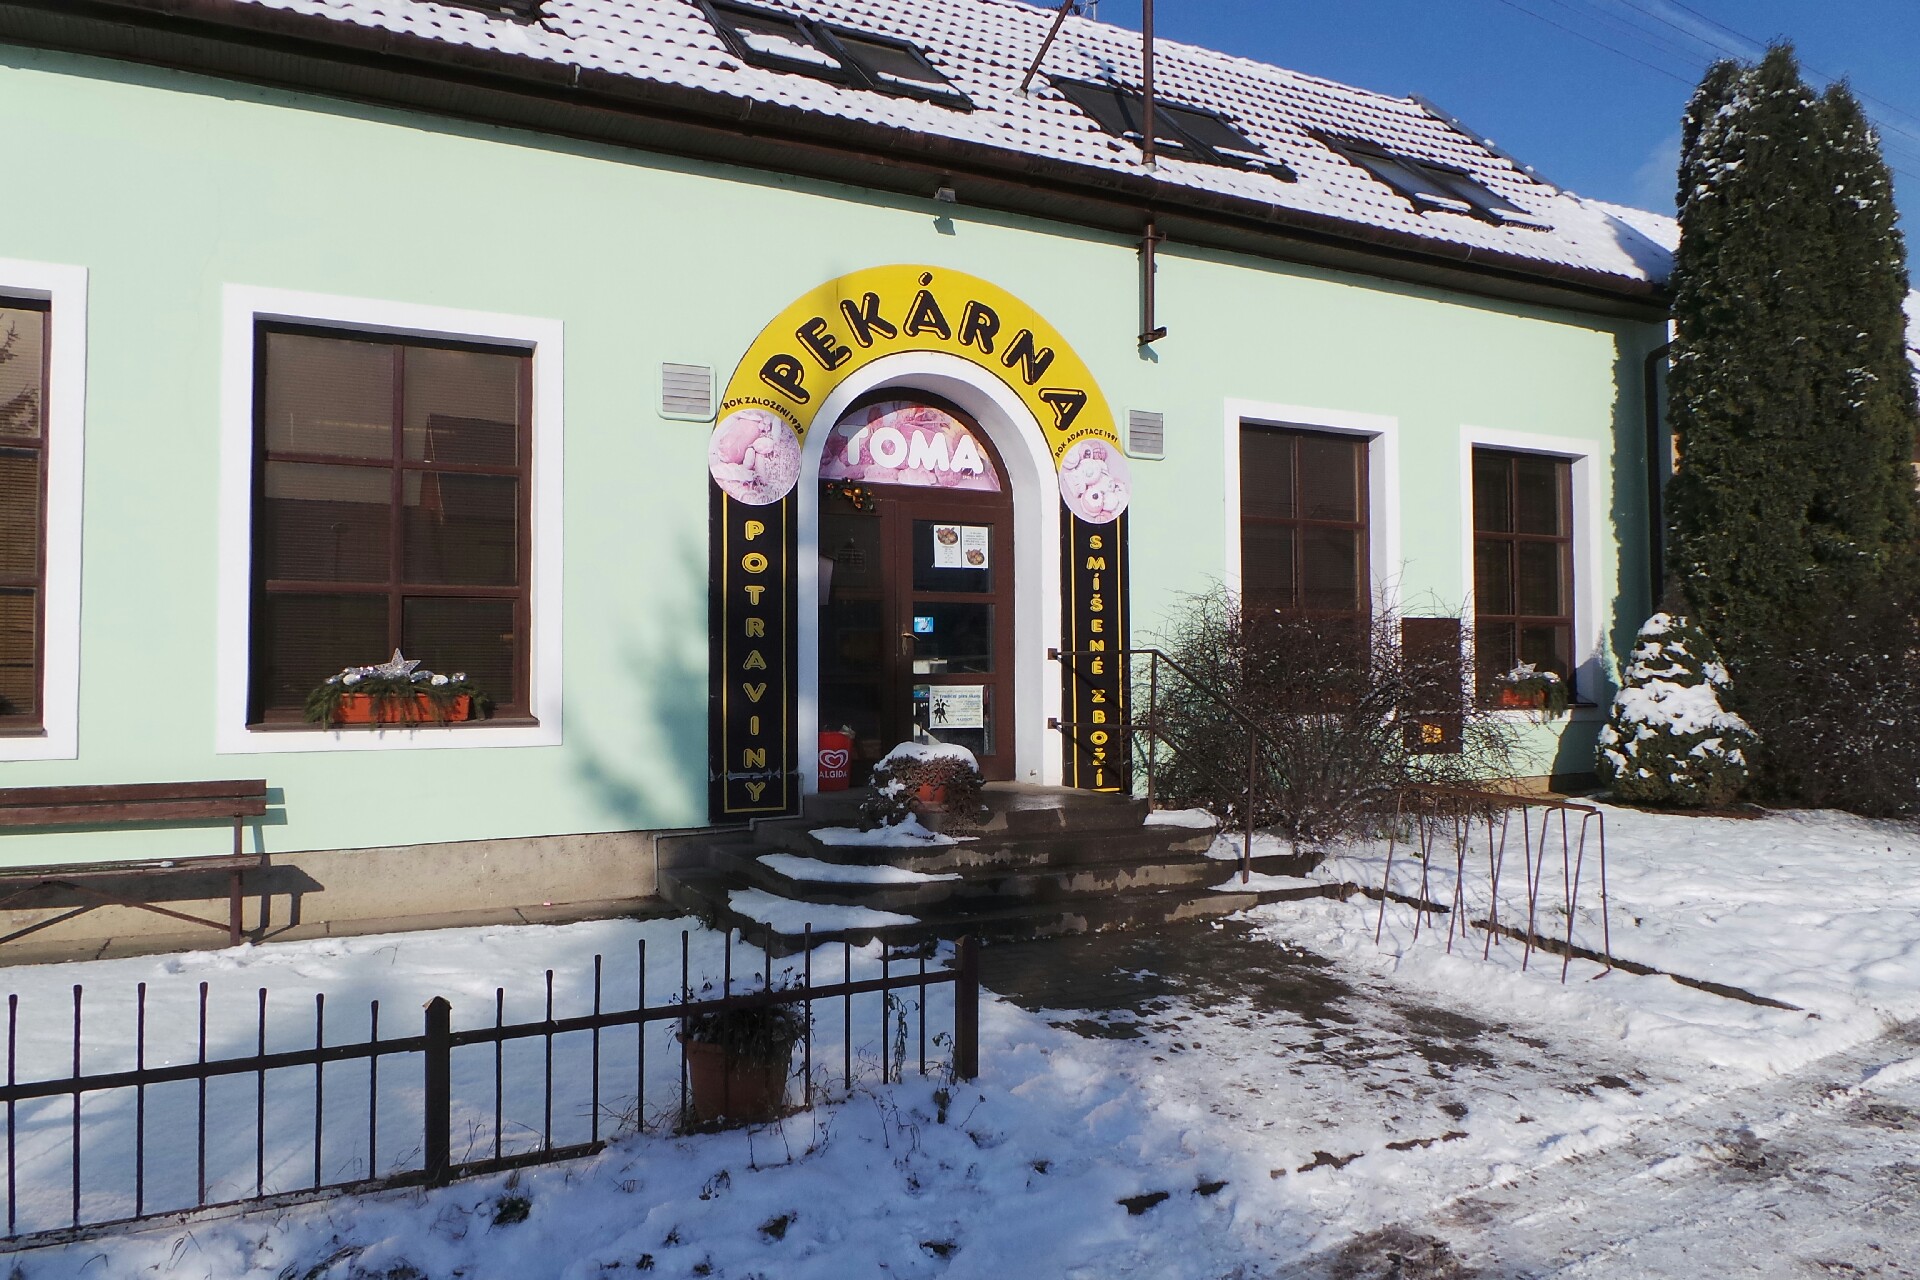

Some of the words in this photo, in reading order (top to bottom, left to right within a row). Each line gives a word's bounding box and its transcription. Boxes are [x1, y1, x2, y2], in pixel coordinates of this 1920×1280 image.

[759, 271, 1088, 432] PEKÁRNA
[722, 398, 744, 410] ROK
[838, 424, 984, 475] TOMA
[1054, 441, 1067, 458] ROK
[1066, 428, 1104, 444] ADAPTACE
[1104, 430, 1118, 443] 1991
[1086, 534, 1106, 675] SMÍŠENÉ
[741, 520, 768, 802] POTRAVINY
[819, 770, 848, 778] ALGIDA
[1090, 689, 1108, 787] ZBOŽÍ
